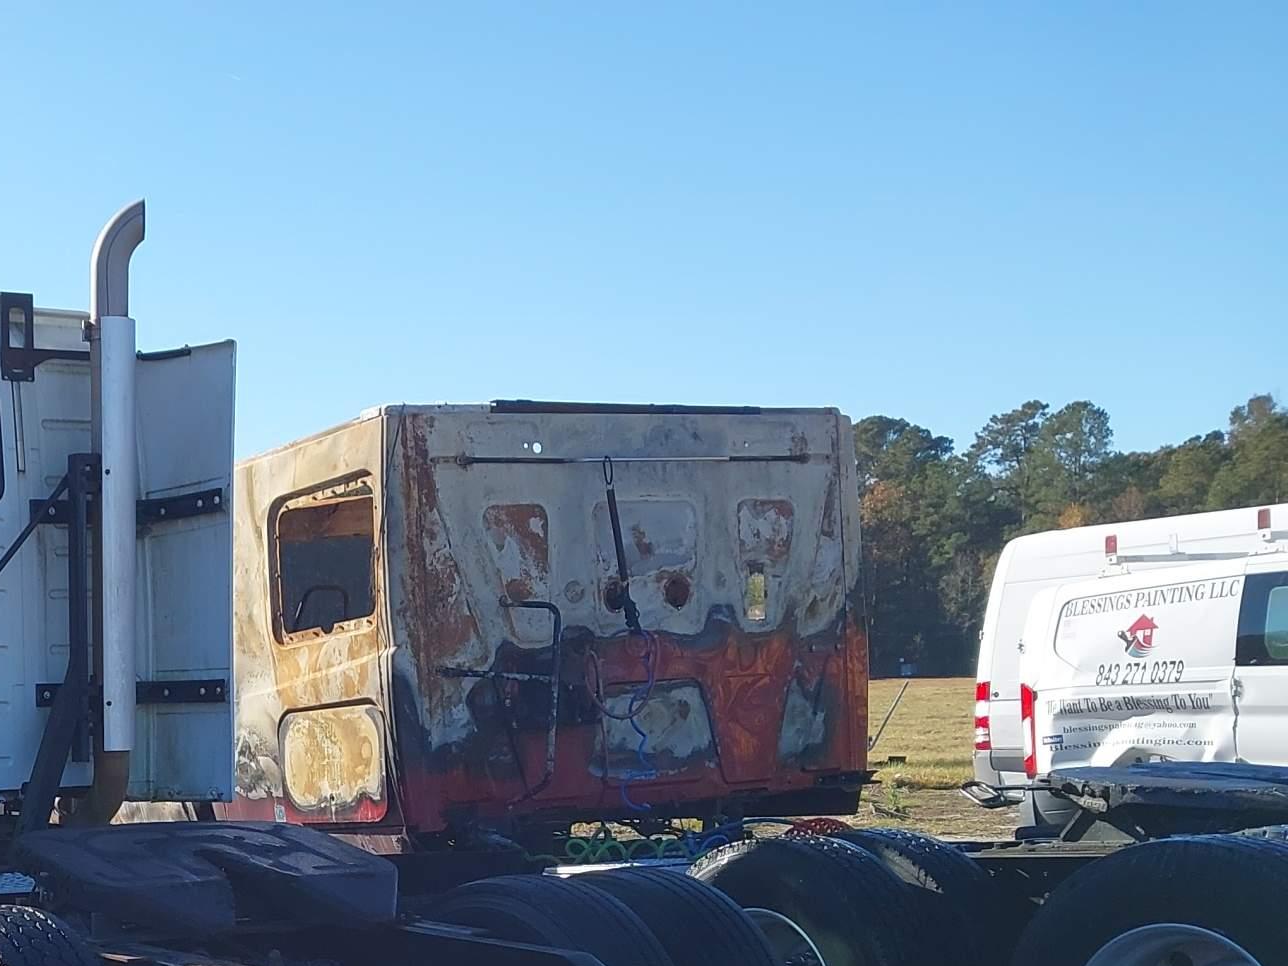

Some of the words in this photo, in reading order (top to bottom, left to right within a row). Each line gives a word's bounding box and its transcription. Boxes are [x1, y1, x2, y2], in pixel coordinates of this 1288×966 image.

[1063, 593, 1133, 618] BLESSINGS
[1134, 583, 1206, 609] PAINTING
[1208, 579, 1241, 600] LLC
[1095, 663, 1121, 686] 843
[1121, 662, 1148, 686] 271
[1150, 659, 1185, 684] 0379
[1083, 697, 1098, 713] To
[1098, 696, 1114, 712] Be
[1114, 699, 1123, 711] a
[1123, 695, 1173, 714] Blessing
[1171, 693, 1187, 710] To
